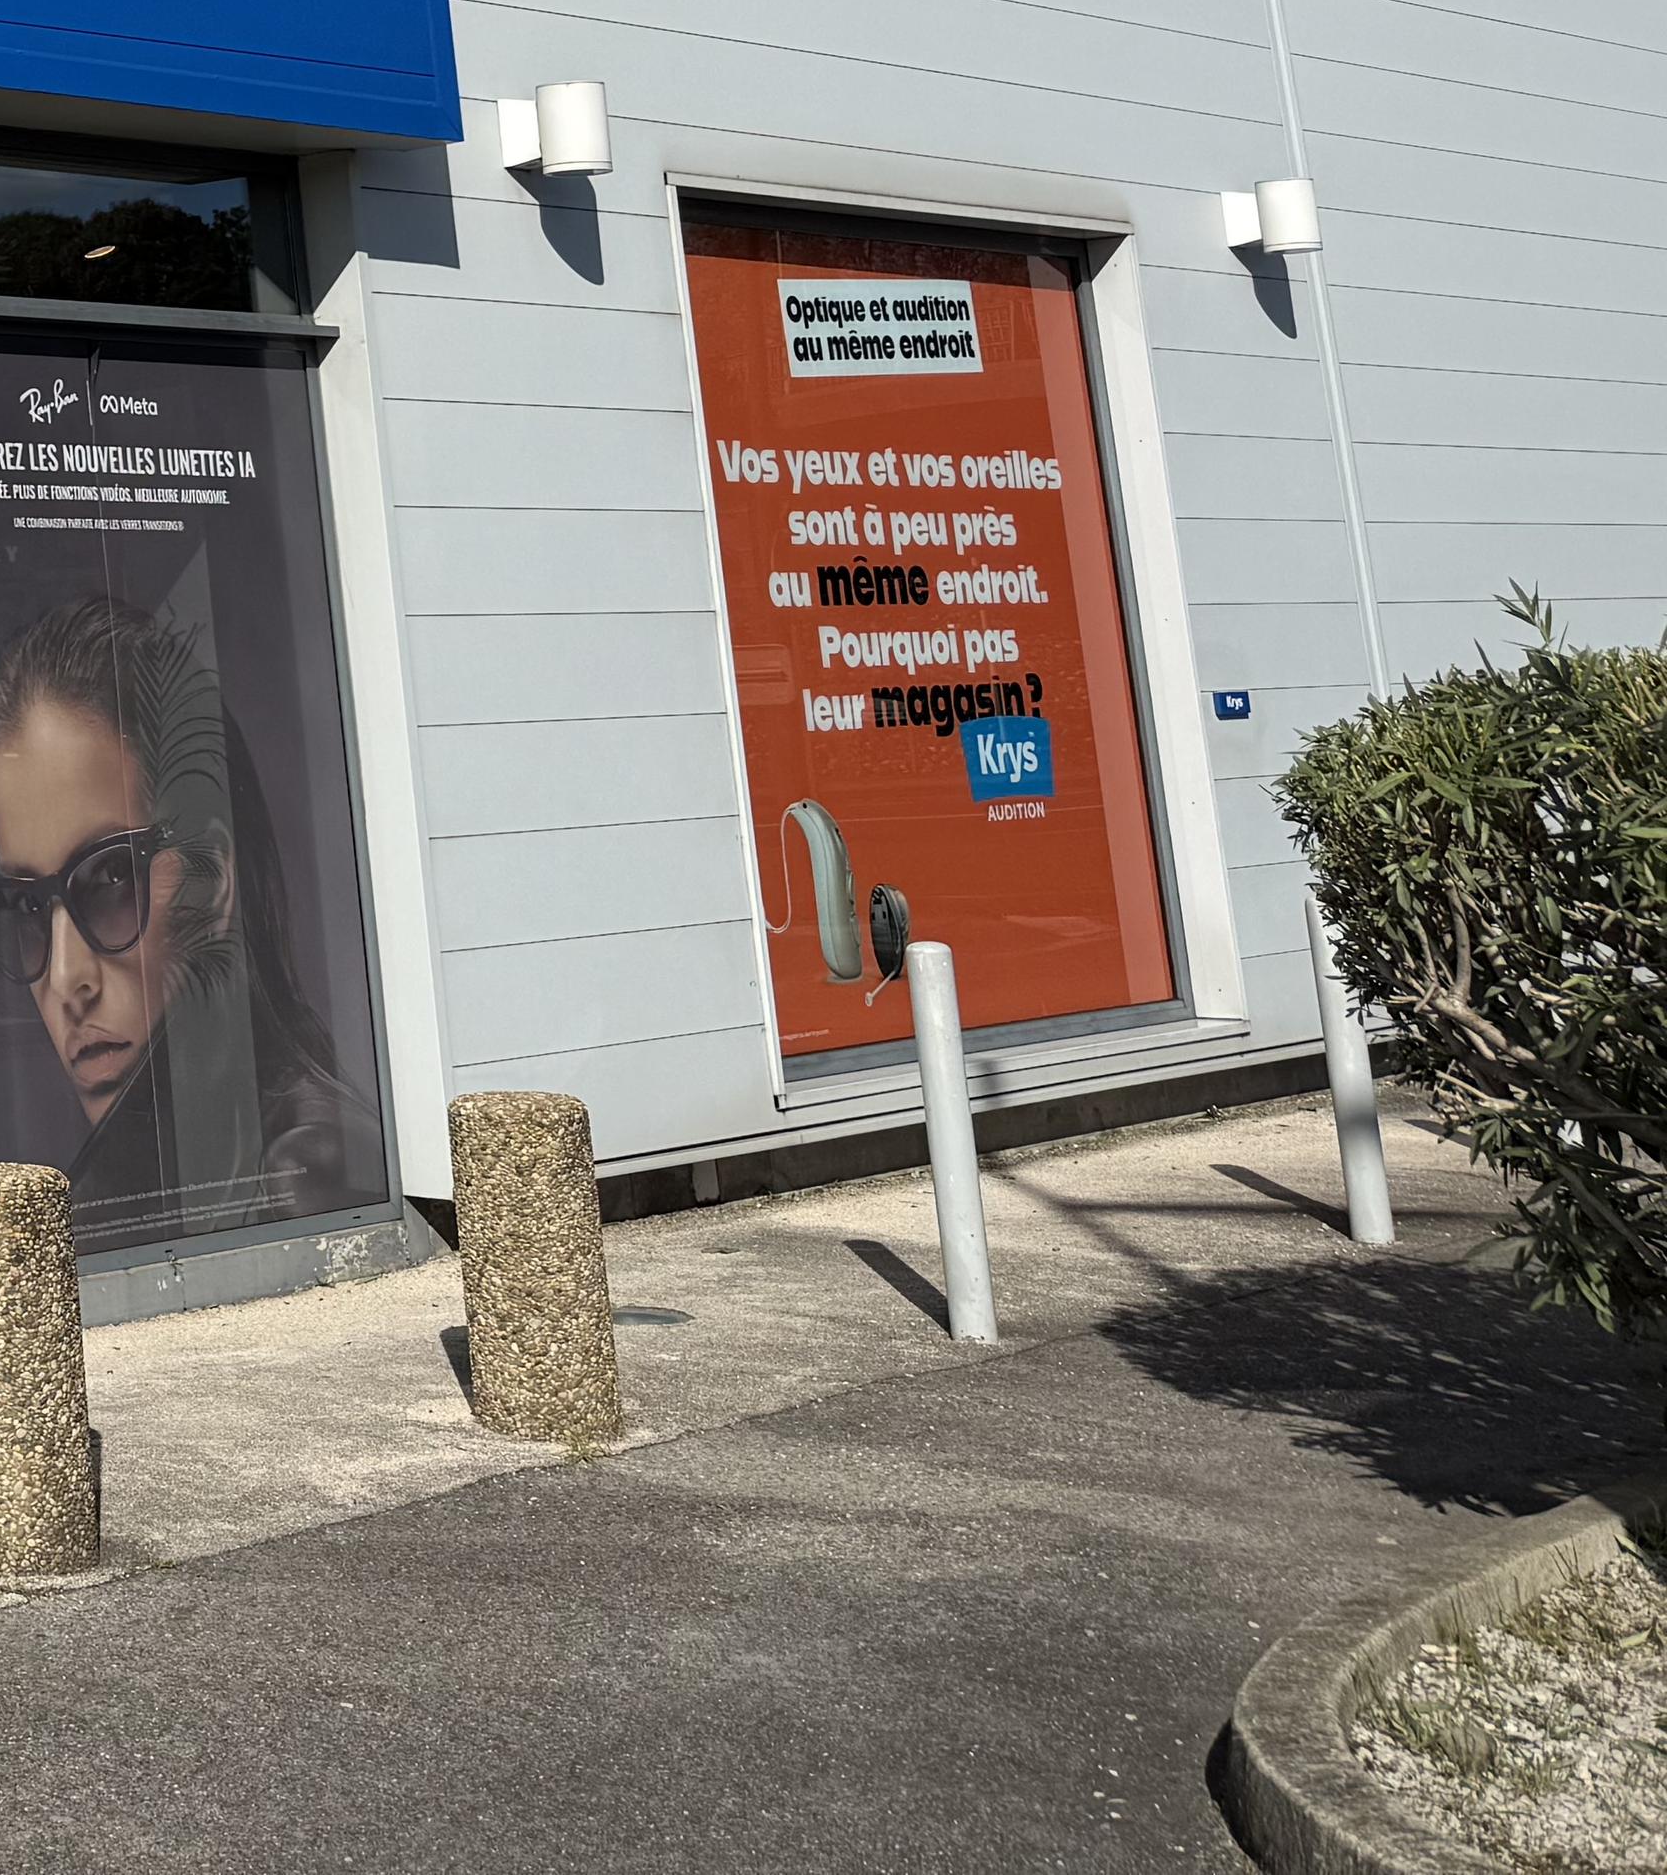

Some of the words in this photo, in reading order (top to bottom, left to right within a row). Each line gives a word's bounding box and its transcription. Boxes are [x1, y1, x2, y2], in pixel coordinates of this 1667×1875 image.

[786, 295, 865, 329] Optique
[869, 297, 890, 321] et
[893, 295, 970, 322] audition
[793, 335, 824, 362] au
[827, 330, 895, 361] même
[899, 330, 975, 359] endroit
[120, 396, 158, 416] Meta
[28, 443, 59, 472] LES
[62, 444, 155, 475] NOUVELLES
[158, 448, 235, 478] LUNETTES
[238, 451, 256, 478] IA
[716, 440, 780, 484] Vos
[783, 449, 864, 494] yeux
[867, 447, 900, 487] et
[902, 453, 956, 488] vos
[960, 450, 1062, 490] oreilles
[12, 484, 36, 499] PLUS
[37, 484, 49, 499] DE
[50, 485, 99, 501] FONCTIONS
[100, 483, 133, 503] VIDÉOS.
[134, 488, 179, 503] MEILLEURE
[181, 489, 230, 505] AUTONOMIE.
[788, 506, 859, 546] sont
[863, 503, 885, 546] à
[889, 510, 948, 555] peu
[952, 505, 1017, 555] près
[768, 571, 812, 608] au
[817, 555, 929, 607] même
[936, 564, 1049, 605] endroit.
[818, 624, 959, 675] Pourquoi
[963, 628, 1019, 673] pas
[802, 689, 865, 732] leur
[1226, 695, 1244, 710] Krys
[977, 732, 1039, 783] Krys
[987, 802, 1046, 822] AUDITION
